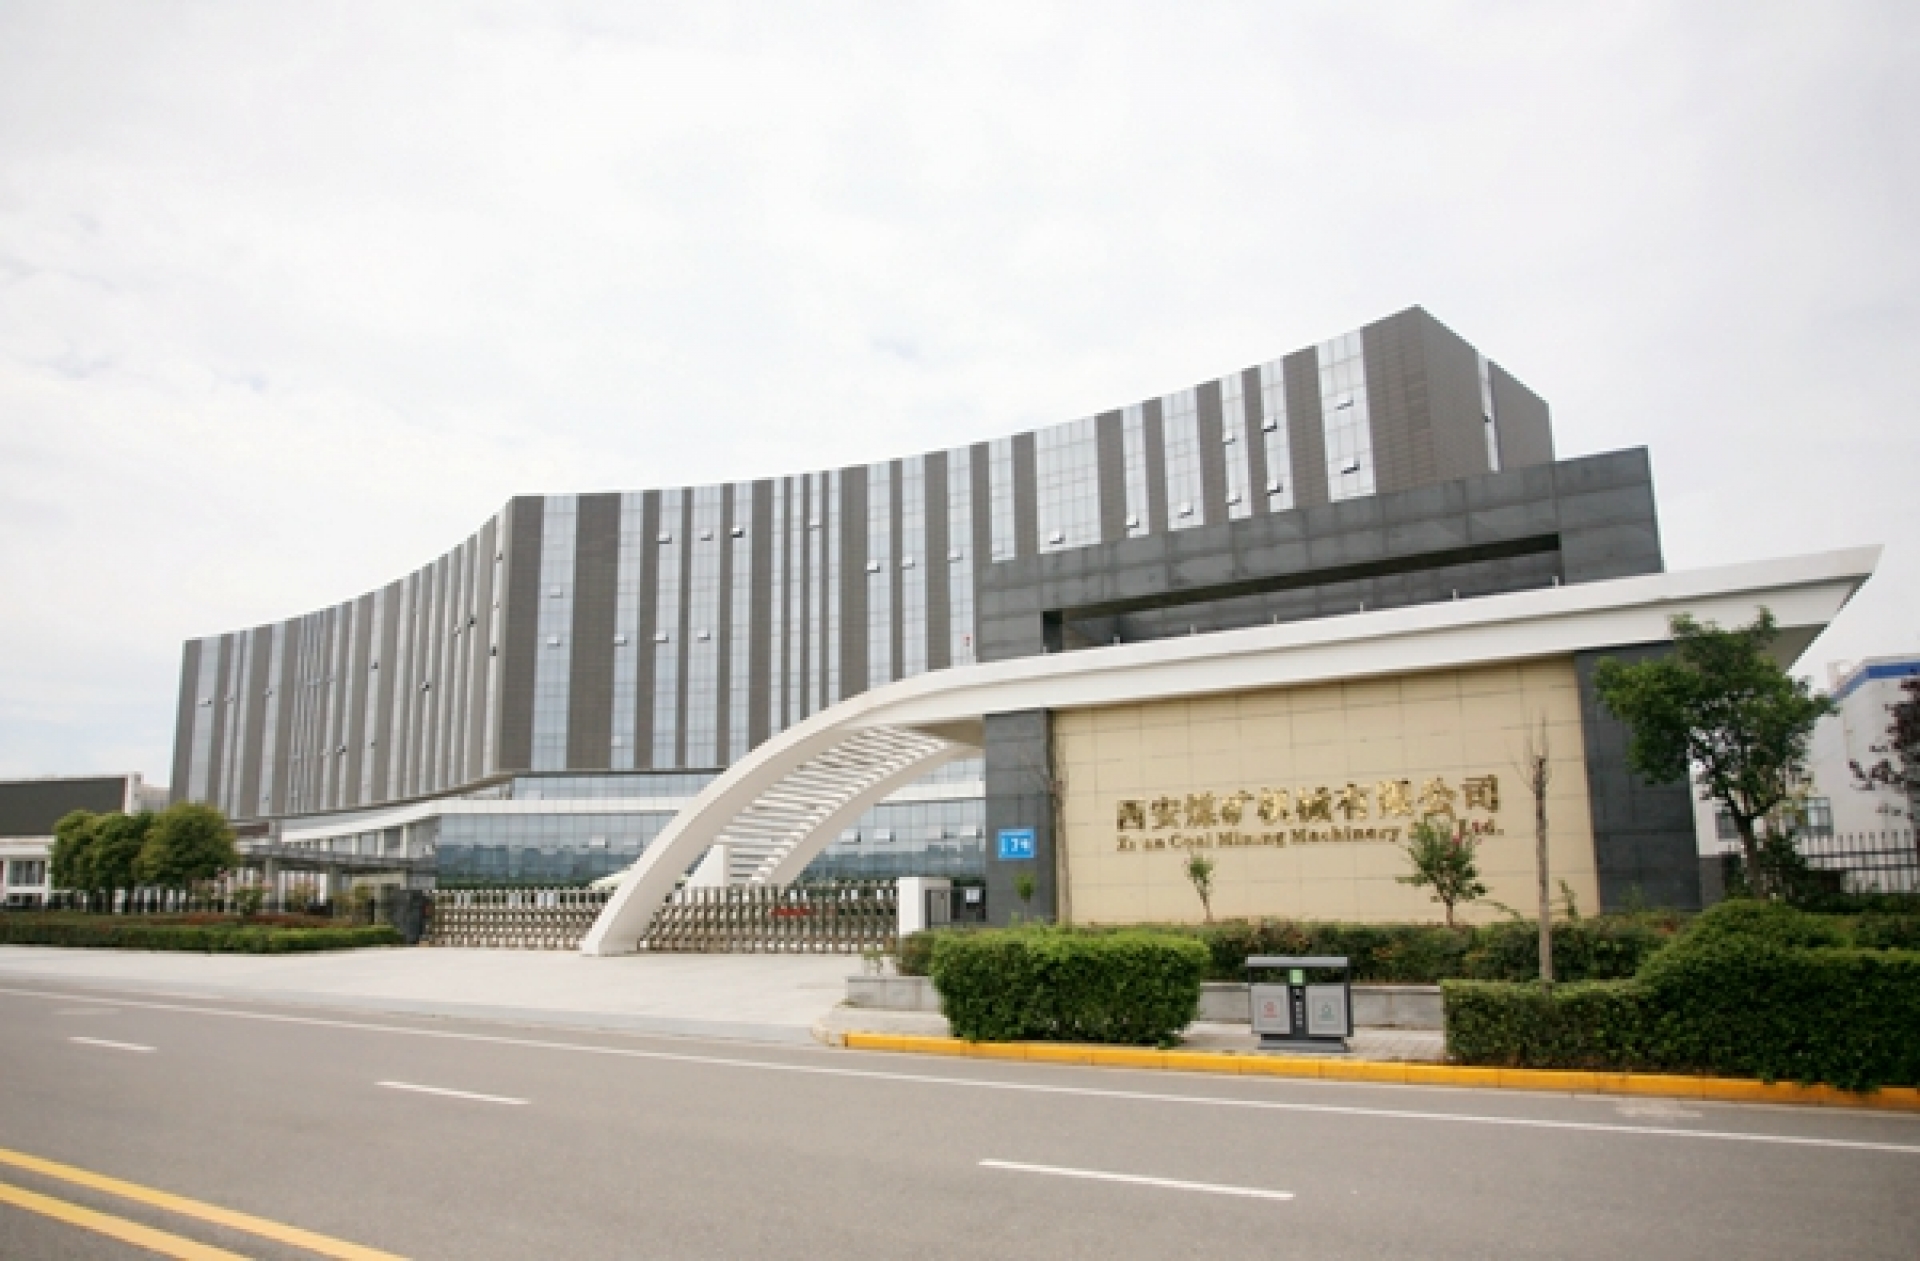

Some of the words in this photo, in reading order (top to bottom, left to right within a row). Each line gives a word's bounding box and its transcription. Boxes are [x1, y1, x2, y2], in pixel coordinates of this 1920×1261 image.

[1170, 832, 1213, 849] Coal
[1218, 830, 1287, 848] Mining
[1290, 825, 1401, 846] Machinery
